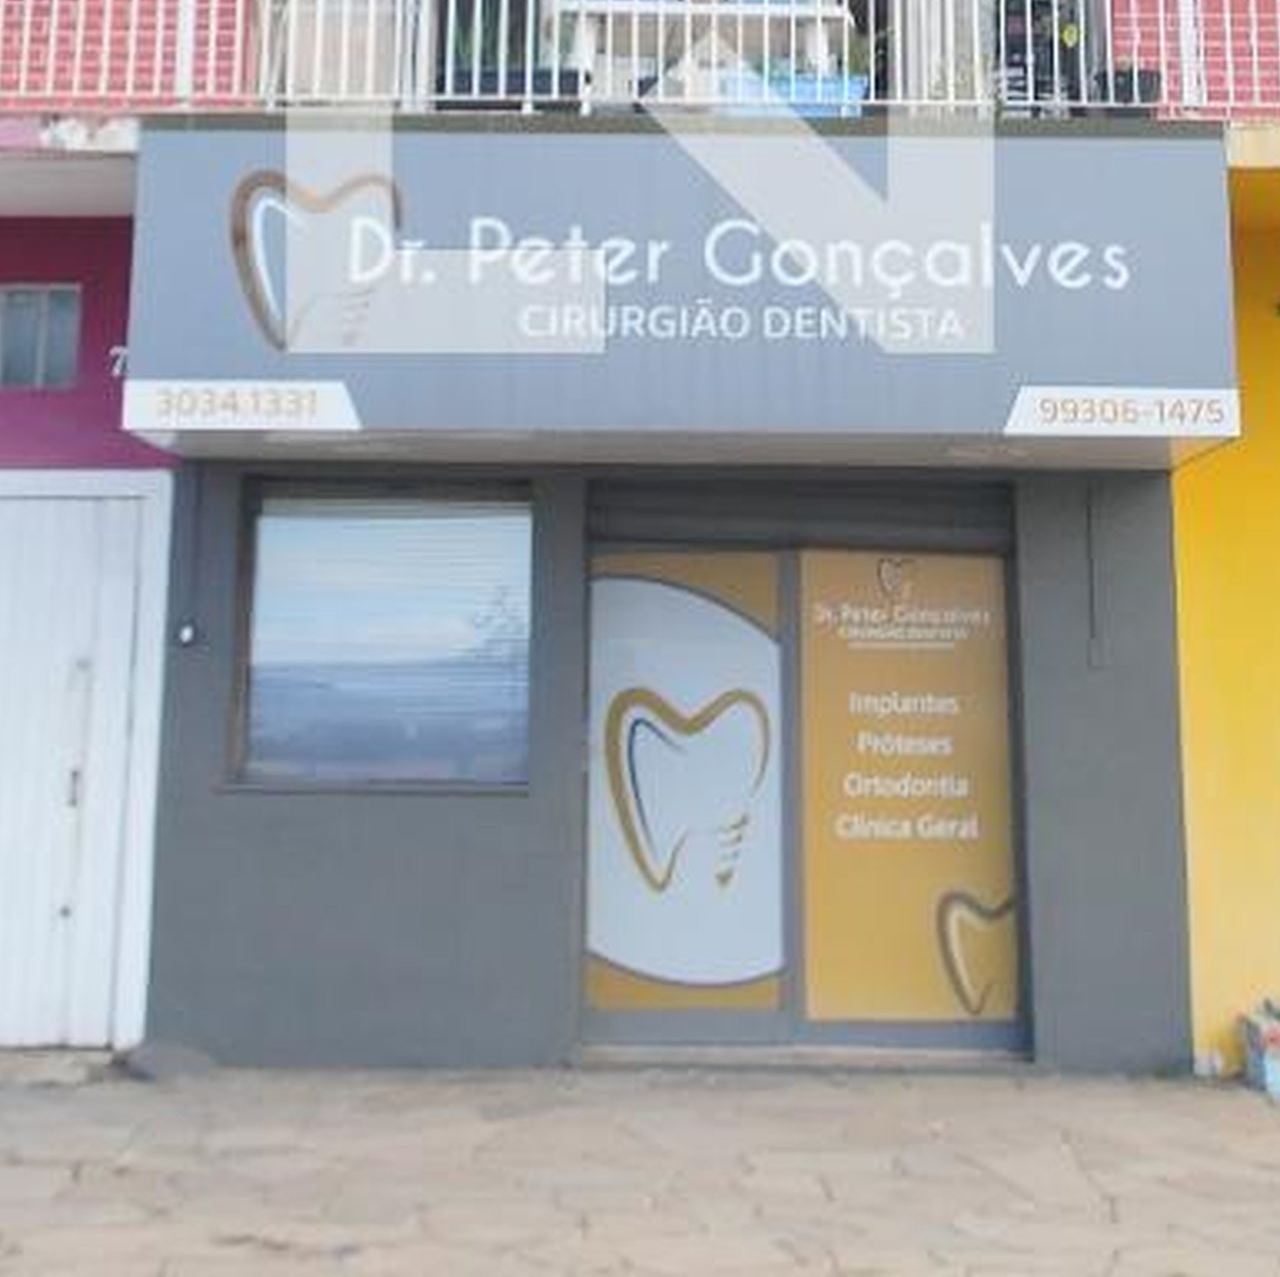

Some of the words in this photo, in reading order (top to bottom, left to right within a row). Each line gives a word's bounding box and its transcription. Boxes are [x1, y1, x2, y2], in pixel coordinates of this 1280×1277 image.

[348, 216, 437, 283] Dr.
[468, 216, 670, 286] Peter
[704, 219, 1130, 299] Gonçalves
[520, 297, 749, 339] CIRURGIÃO
[763, 306, 966, 341] DENTISTA
[1038, 397, 1226, 425] 99306-1475
[849, 691, 960, 718] Implantes
[857, 729, 953, 756] Próteses
[844, 773, 969, 798] Ortodontia
[918, 812, 979, 839] Geral
